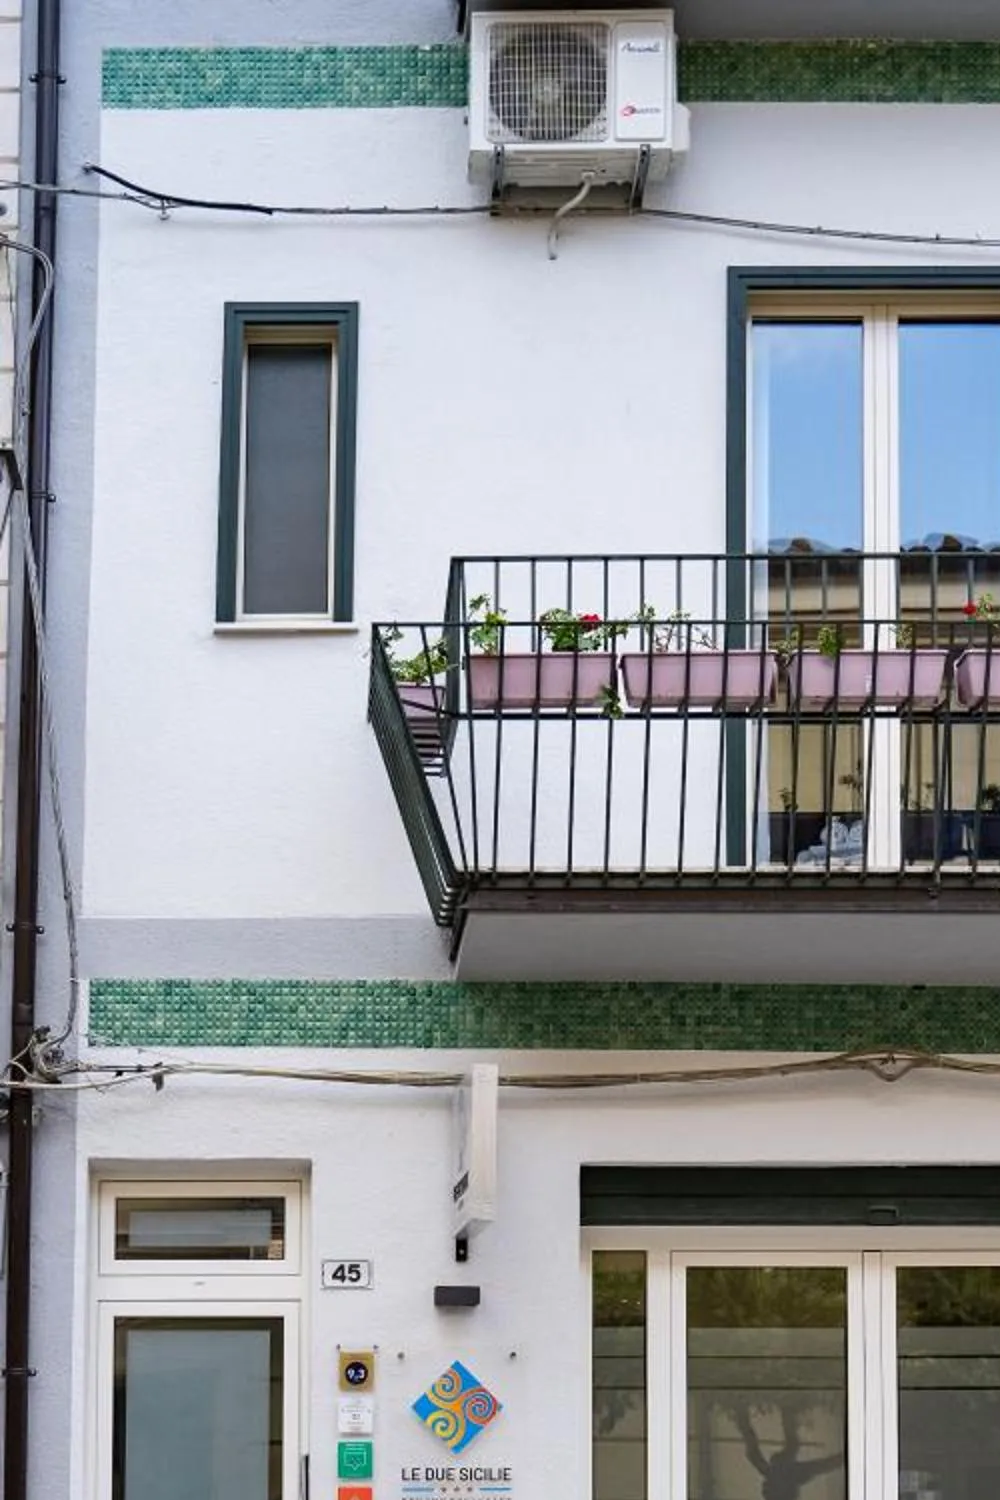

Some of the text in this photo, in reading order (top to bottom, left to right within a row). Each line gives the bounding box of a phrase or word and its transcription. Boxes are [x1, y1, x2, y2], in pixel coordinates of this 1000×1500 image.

[331, 1263, 361, 1283] 45
[401, 1467, 512, 1481] LE DUE SICILIE
